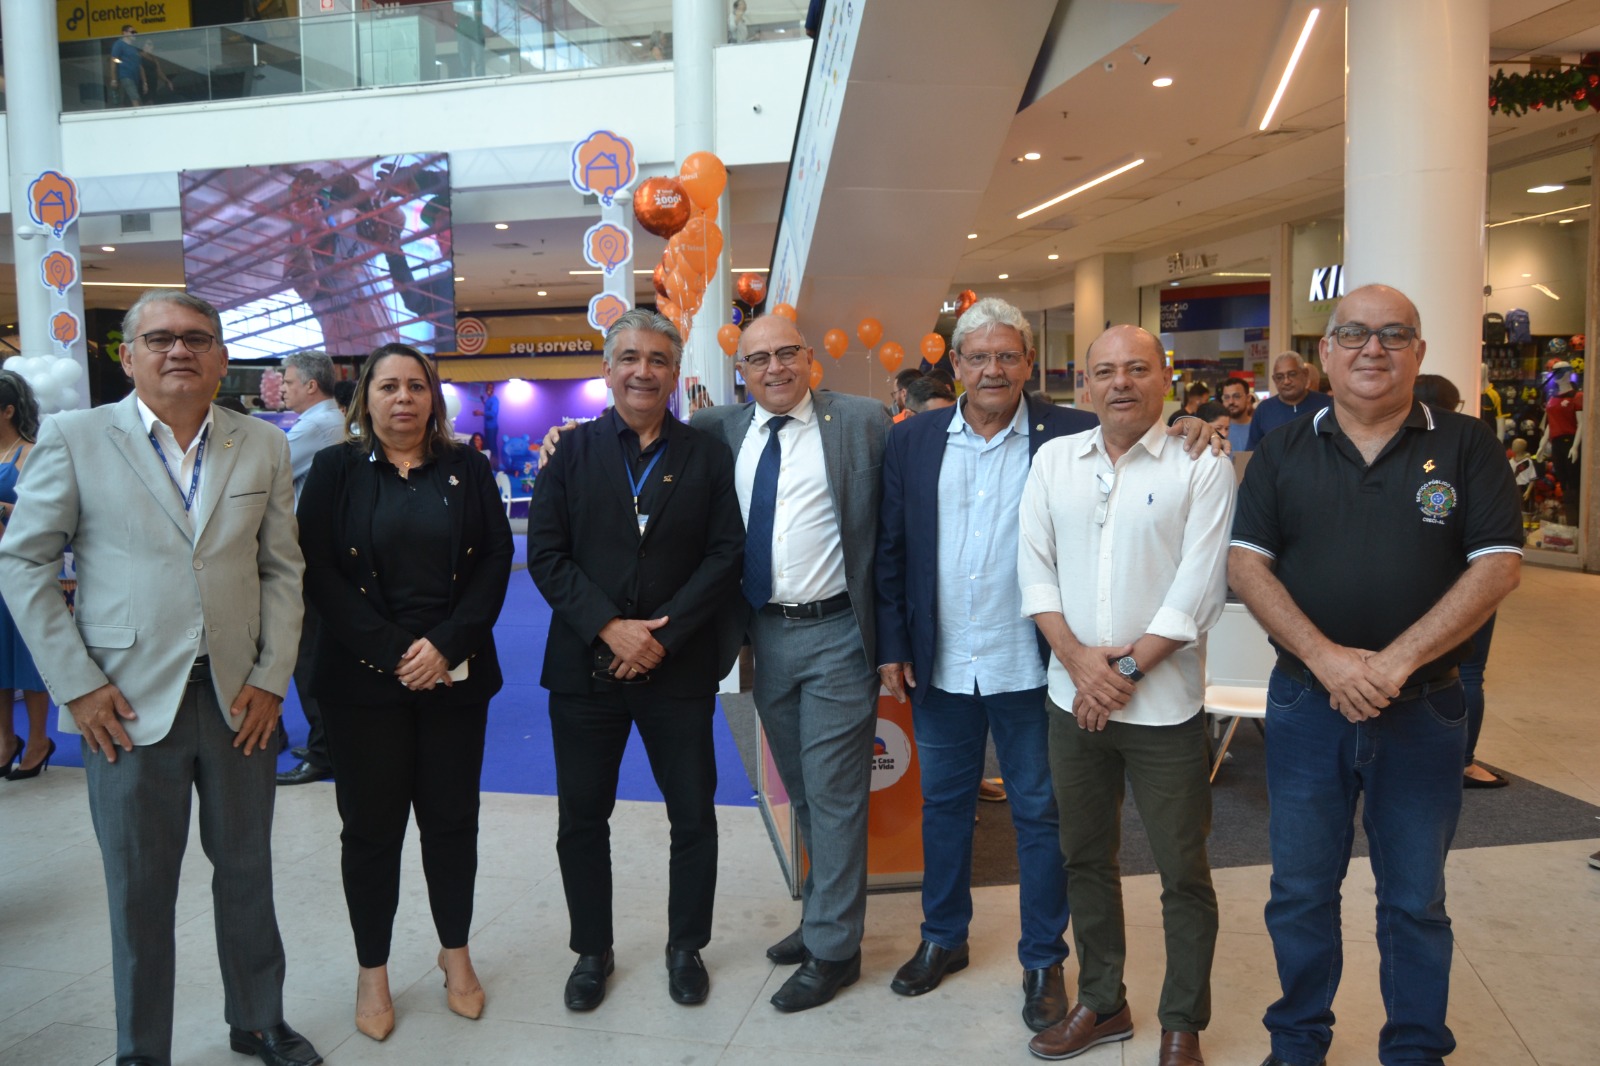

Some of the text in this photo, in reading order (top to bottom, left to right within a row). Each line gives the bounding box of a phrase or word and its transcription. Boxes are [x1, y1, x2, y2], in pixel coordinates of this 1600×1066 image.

[91, 1, 166, 22] centerplex
[510, 338, 593, 354] seu sorvete
